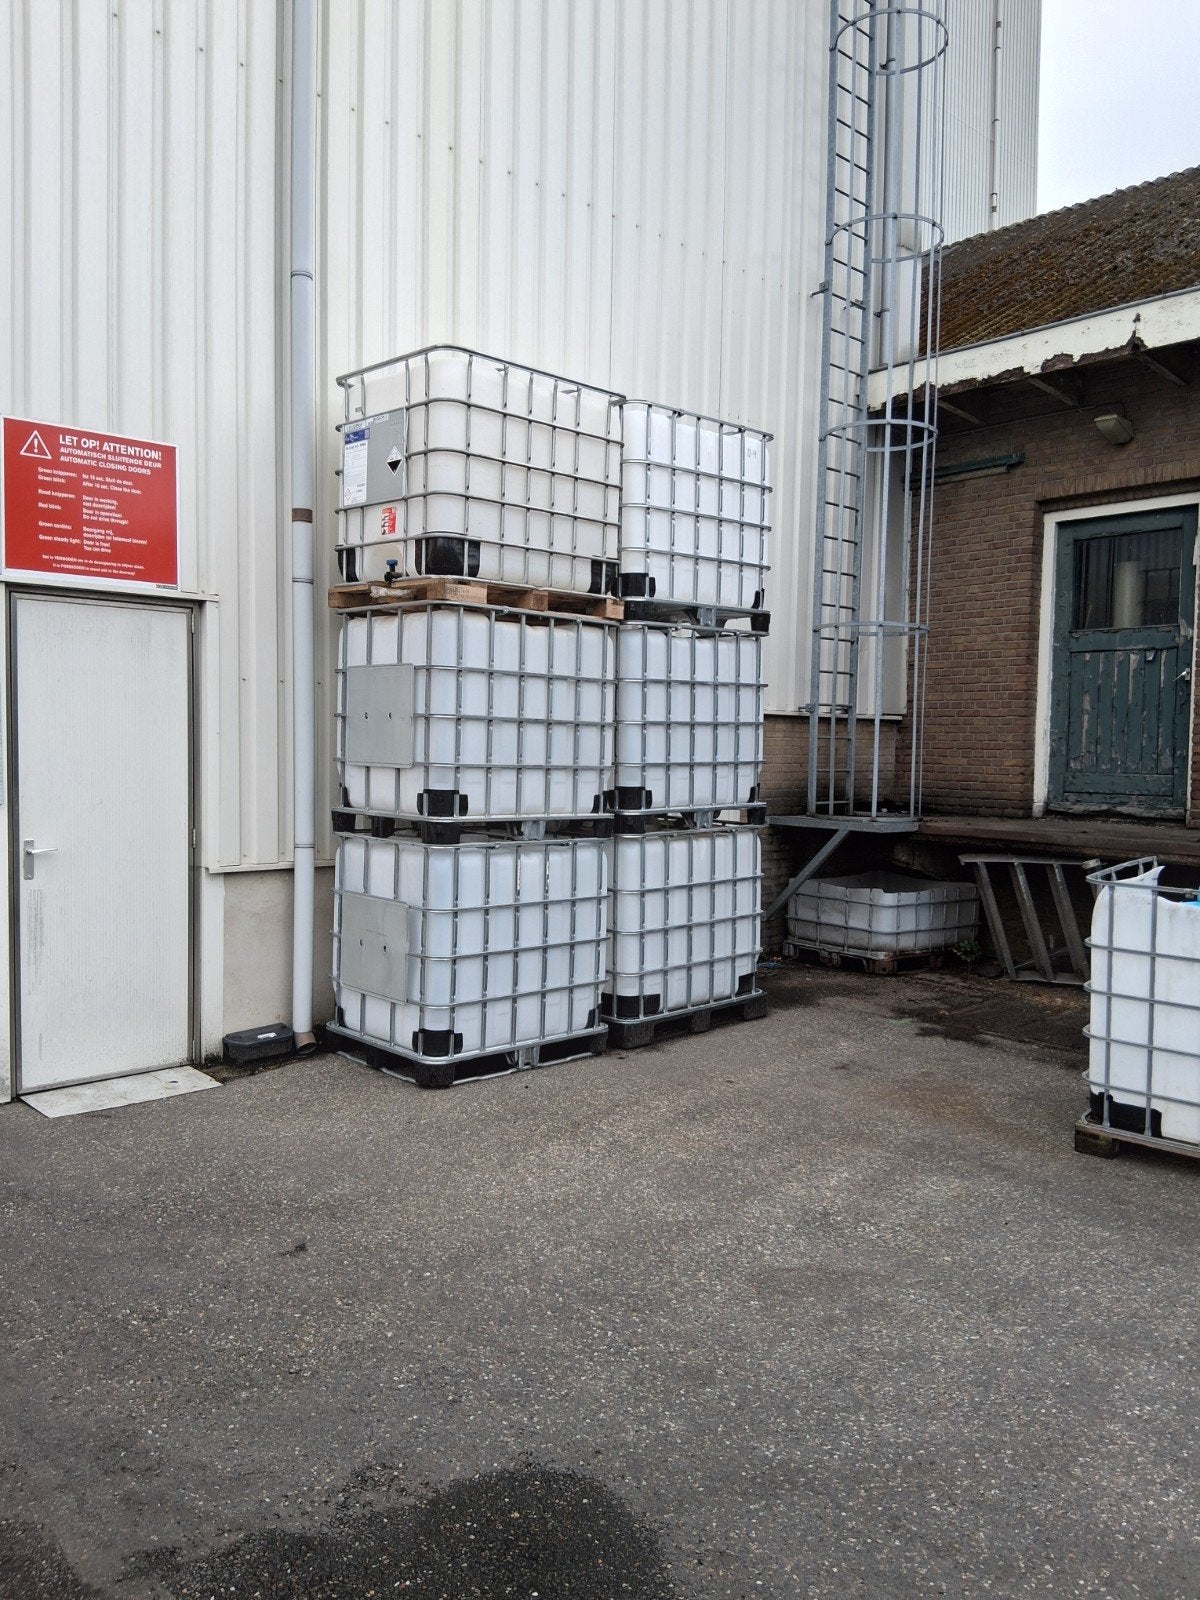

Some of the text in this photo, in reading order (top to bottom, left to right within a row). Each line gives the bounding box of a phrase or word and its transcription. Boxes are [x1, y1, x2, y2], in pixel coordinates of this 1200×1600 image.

[59, 434, 162, 460] LET OP! ATTENTION!
[60, 447, 162, 468] AUTOMATISCH SLUITENDE DEUR
[60, 456, 151, 475] AUTOMATIC CLOSING DOORS
